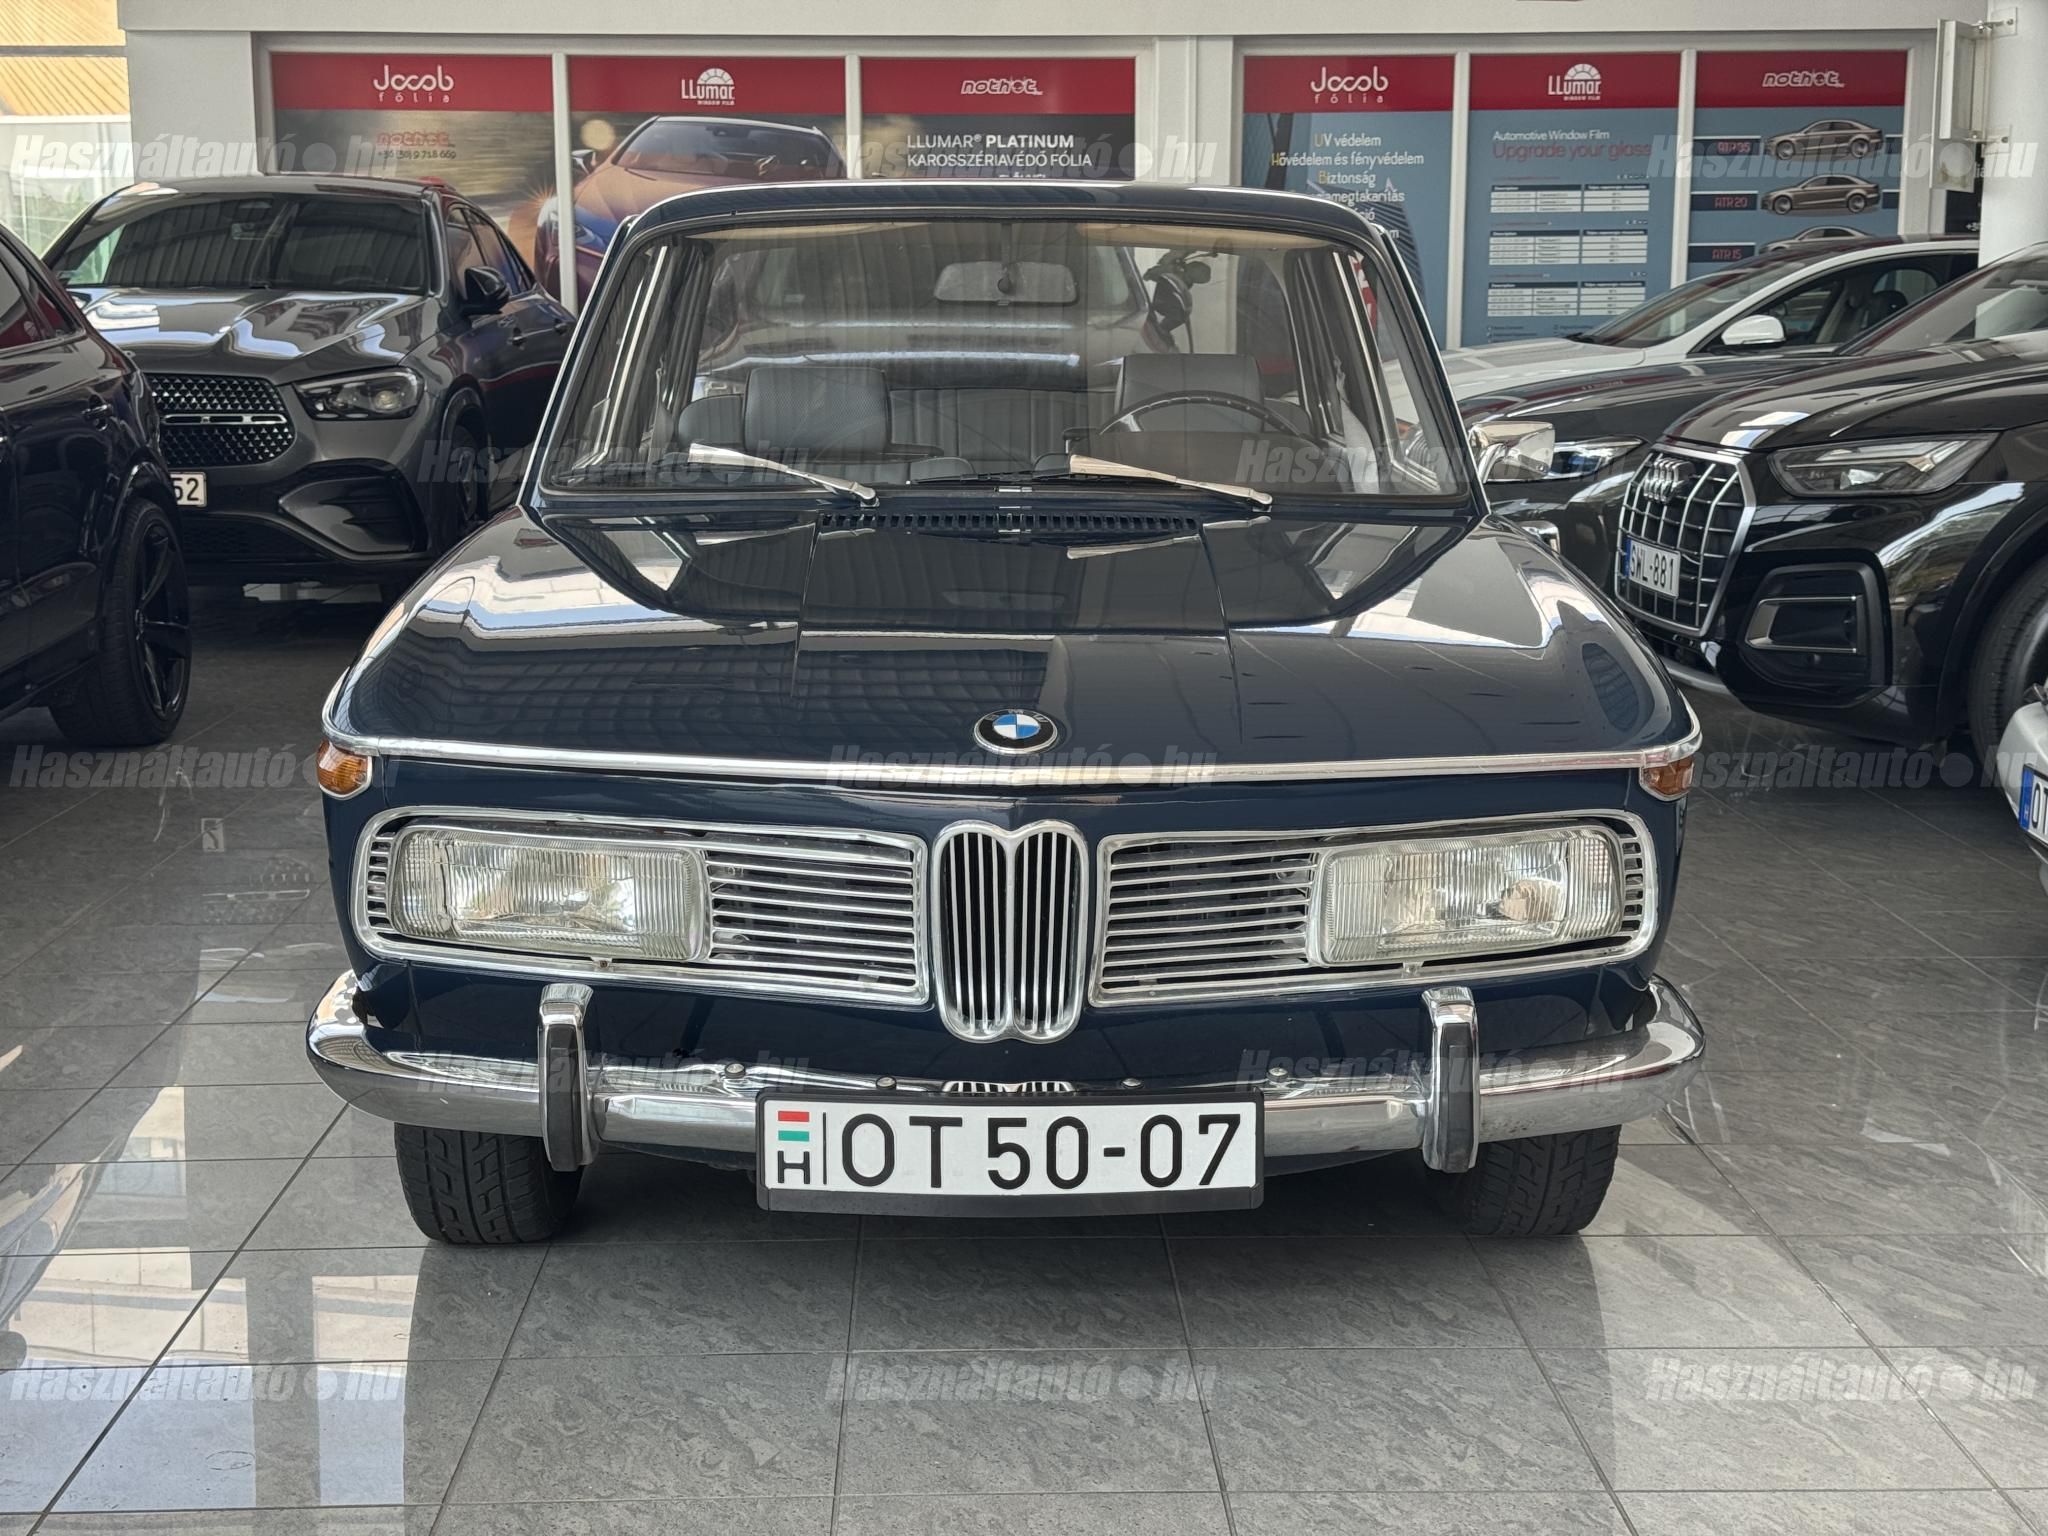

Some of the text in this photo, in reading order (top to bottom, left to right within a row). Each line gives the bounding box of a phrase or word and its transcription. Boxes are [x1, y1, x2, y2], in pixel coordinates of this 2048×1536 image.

[681, 78, 735, 100] LLumar
[1548, 76, 1602, 96] LLumar
[379, 92, 450, 103] fólia
[1314, 92, 1384, 103] fólia
[985, 135, 1074, 148] PLATINUM
[1314, 133, 1382, 147] UV védelem
[1493, 128, 1610, 141] Automotive Window Film
[1050, 151, 1092, 167] FÓLIA
[1334, 151, 1348, 166] és
[1494, 143, 1565, 162] Upgrade
[1566, 143, 1604, 161] your
[1318, 170, 1376, 189] Biztonság
[987, 1113, 1241, 1189] 50-07
